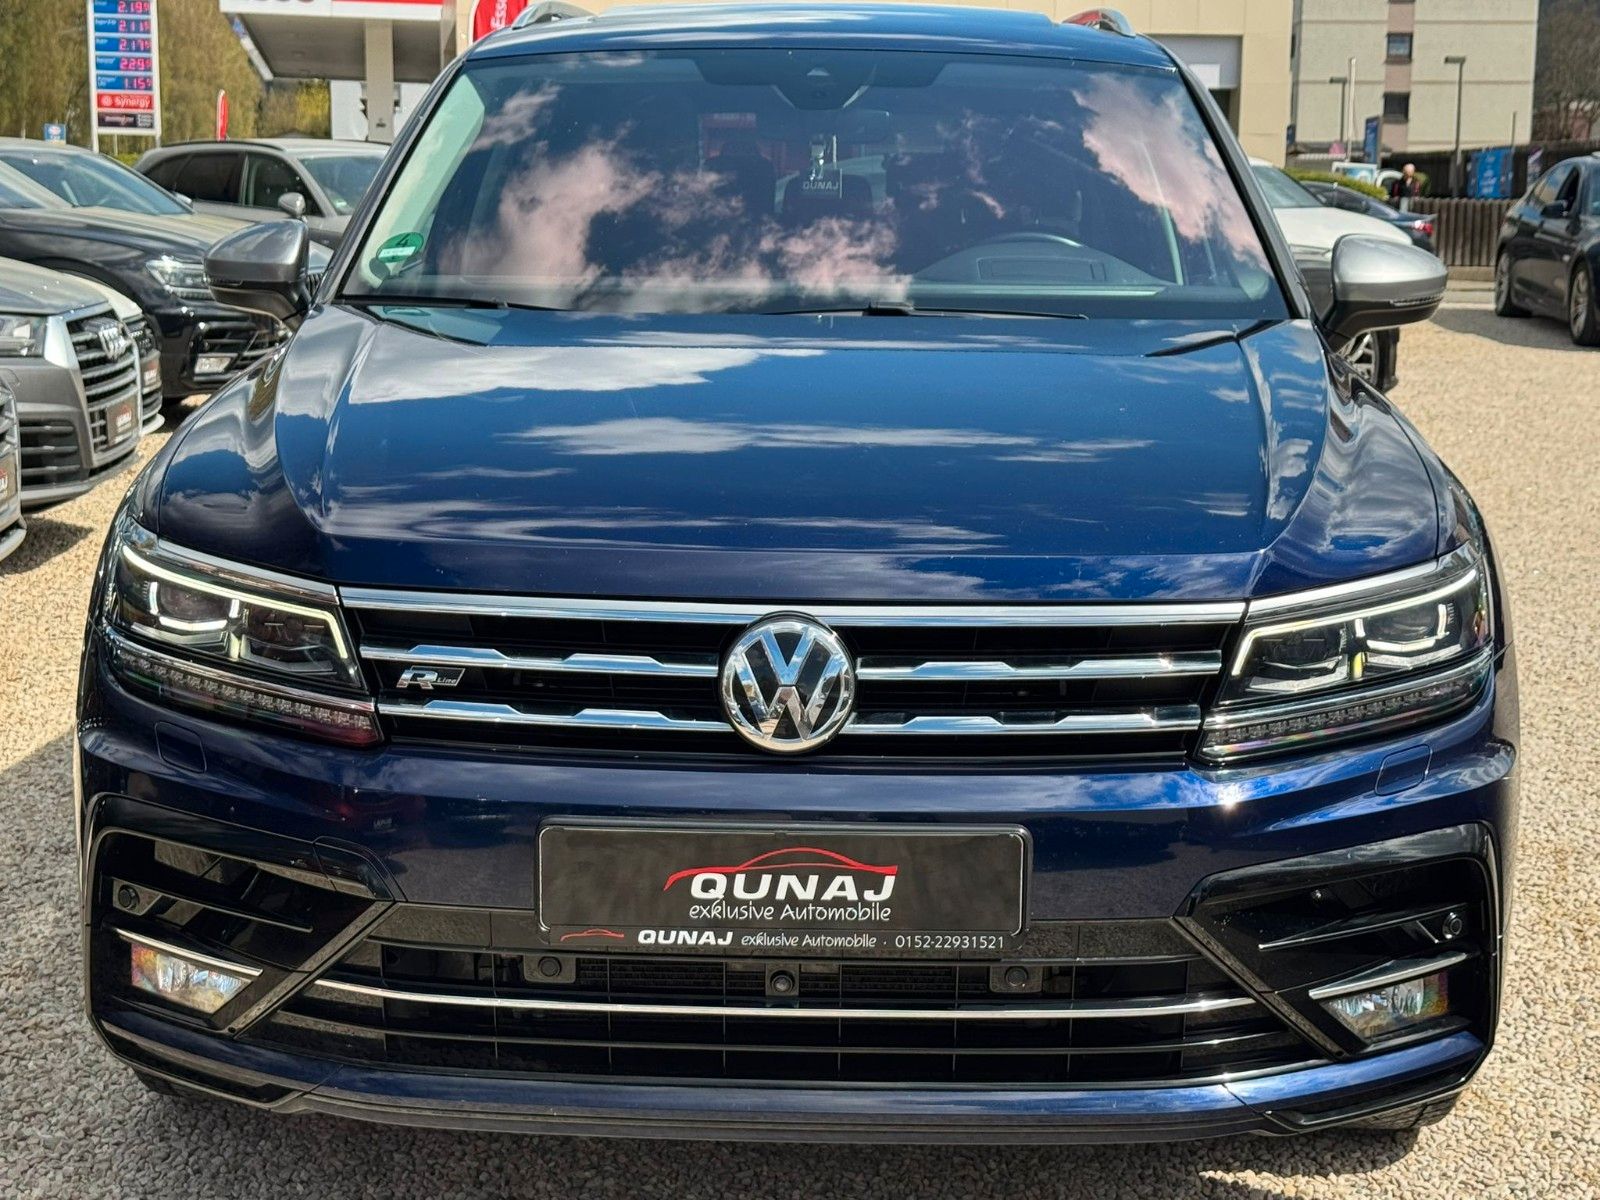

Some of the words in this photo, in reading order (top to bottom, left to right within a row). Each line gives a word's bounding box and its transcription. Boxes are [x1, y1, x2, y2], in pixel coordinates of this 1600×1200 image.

[490, 0, 507, 30] Ess
[113, 95, 151, 108] Synergy
[395, 233, 411, 247] 4
[690, 872, 897, 901] QUNAJ
[689, 899, 775, 921] exklusive
[780, 901, 892, 922] Automobile
[637, 929, 734, 946] QUNAJ
[741, 931, 800, 947] exklusive
[802, 933, 877, 949] Automobile
[895, 935, 1004, 949] 0152-22931521
